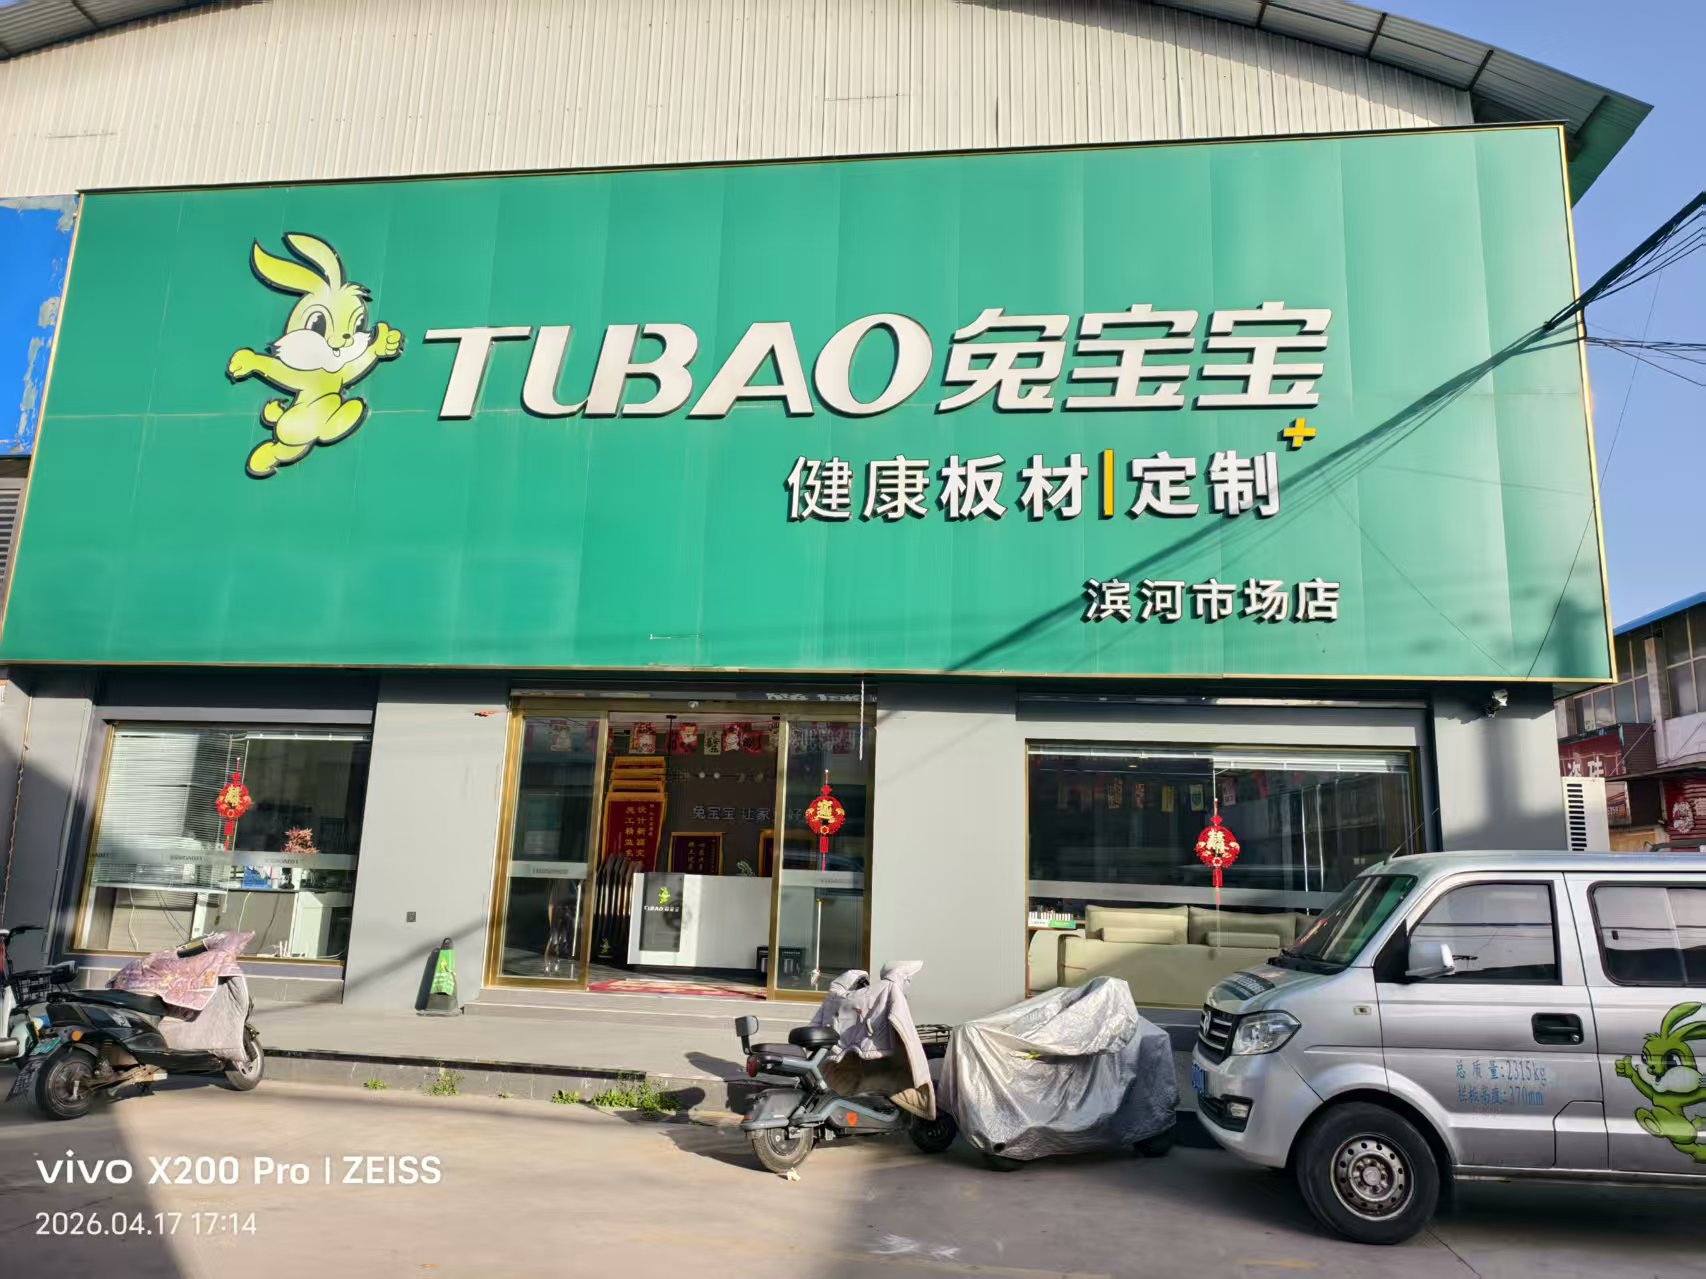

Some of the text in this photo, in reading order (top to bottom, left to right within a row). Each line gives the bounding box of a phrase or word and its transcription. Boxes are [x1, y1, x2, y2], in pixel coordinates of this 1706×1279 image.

[424, 302, 1332, 419] TUBAO 兔宝宝
[786, 449, 1281, 521] 健康板材 定制
[1084, 576, 1341, 624] 滨河市场店
[742, 806, 802, 821] 让家好
